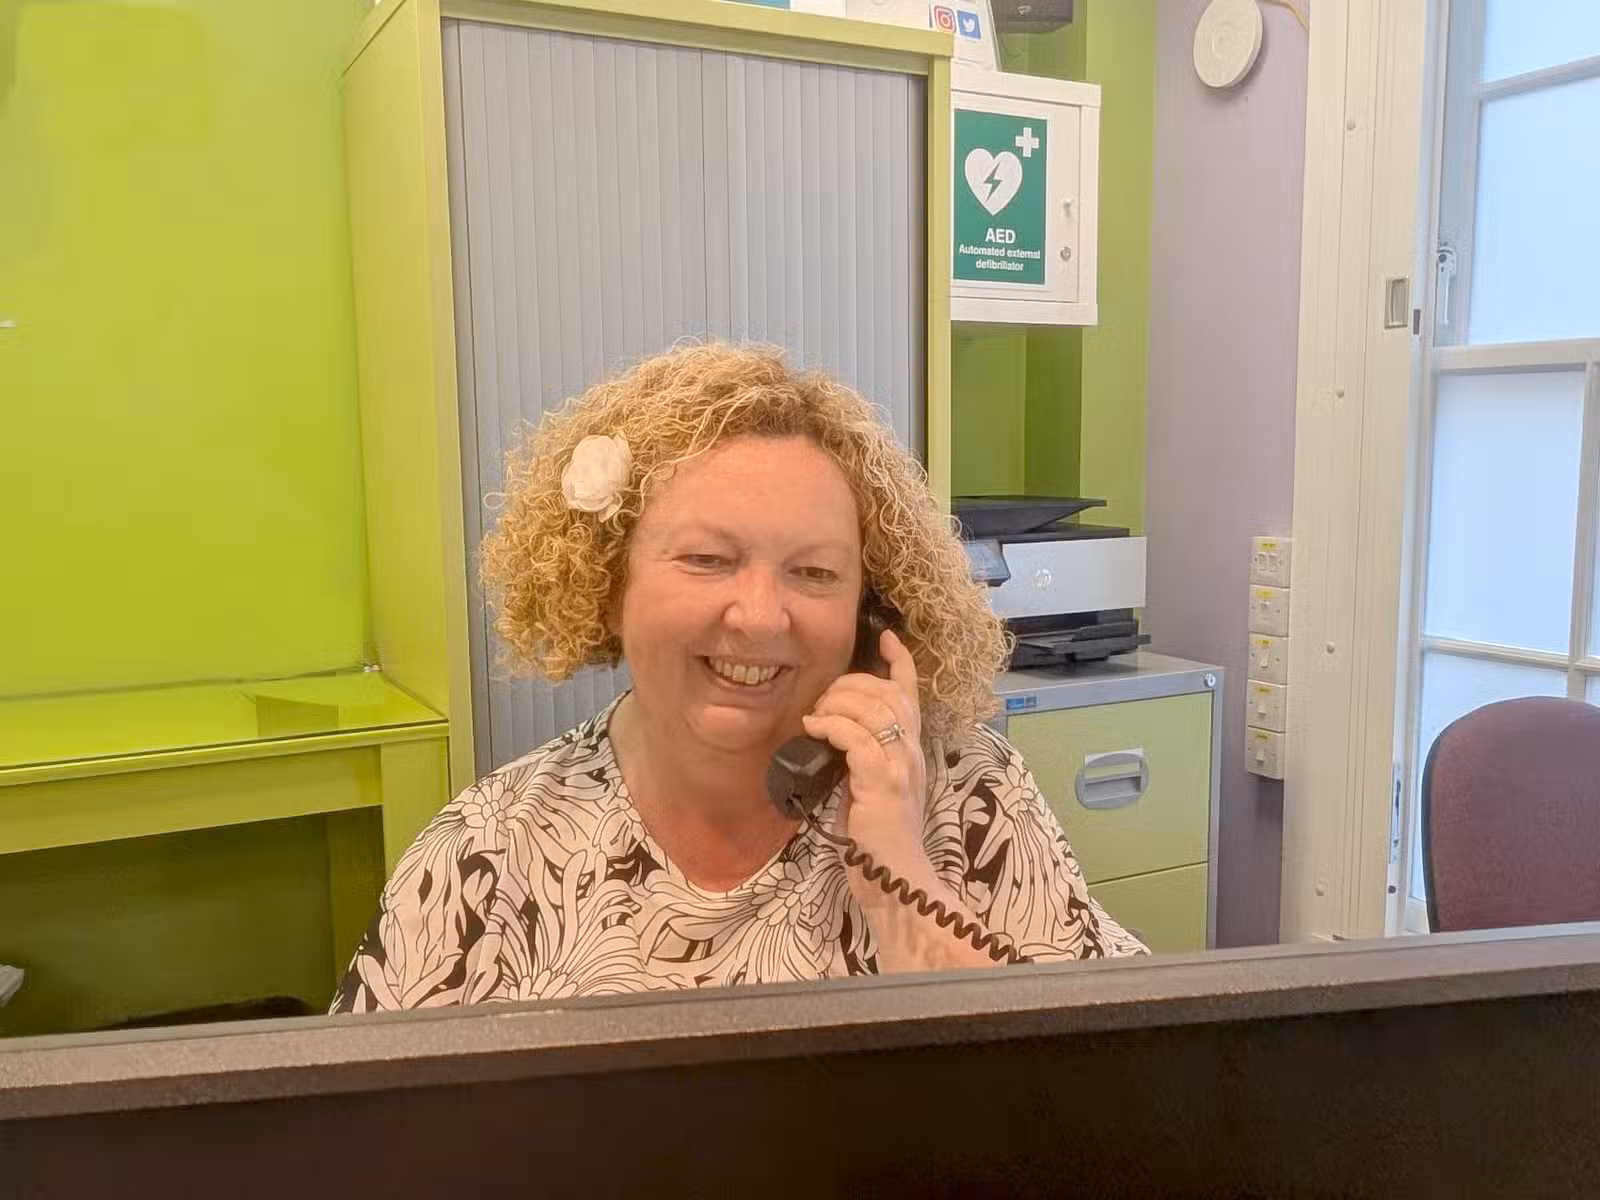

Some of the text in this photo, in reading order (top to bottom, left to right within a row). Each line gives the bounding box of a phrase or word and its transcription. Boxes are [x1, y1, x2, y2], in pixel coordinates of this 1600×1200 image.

[985, 227, 1016, 244] AED
[959, 244, 1040, 259] Automated external
[975, 259, 1024, 271] defibrillator
